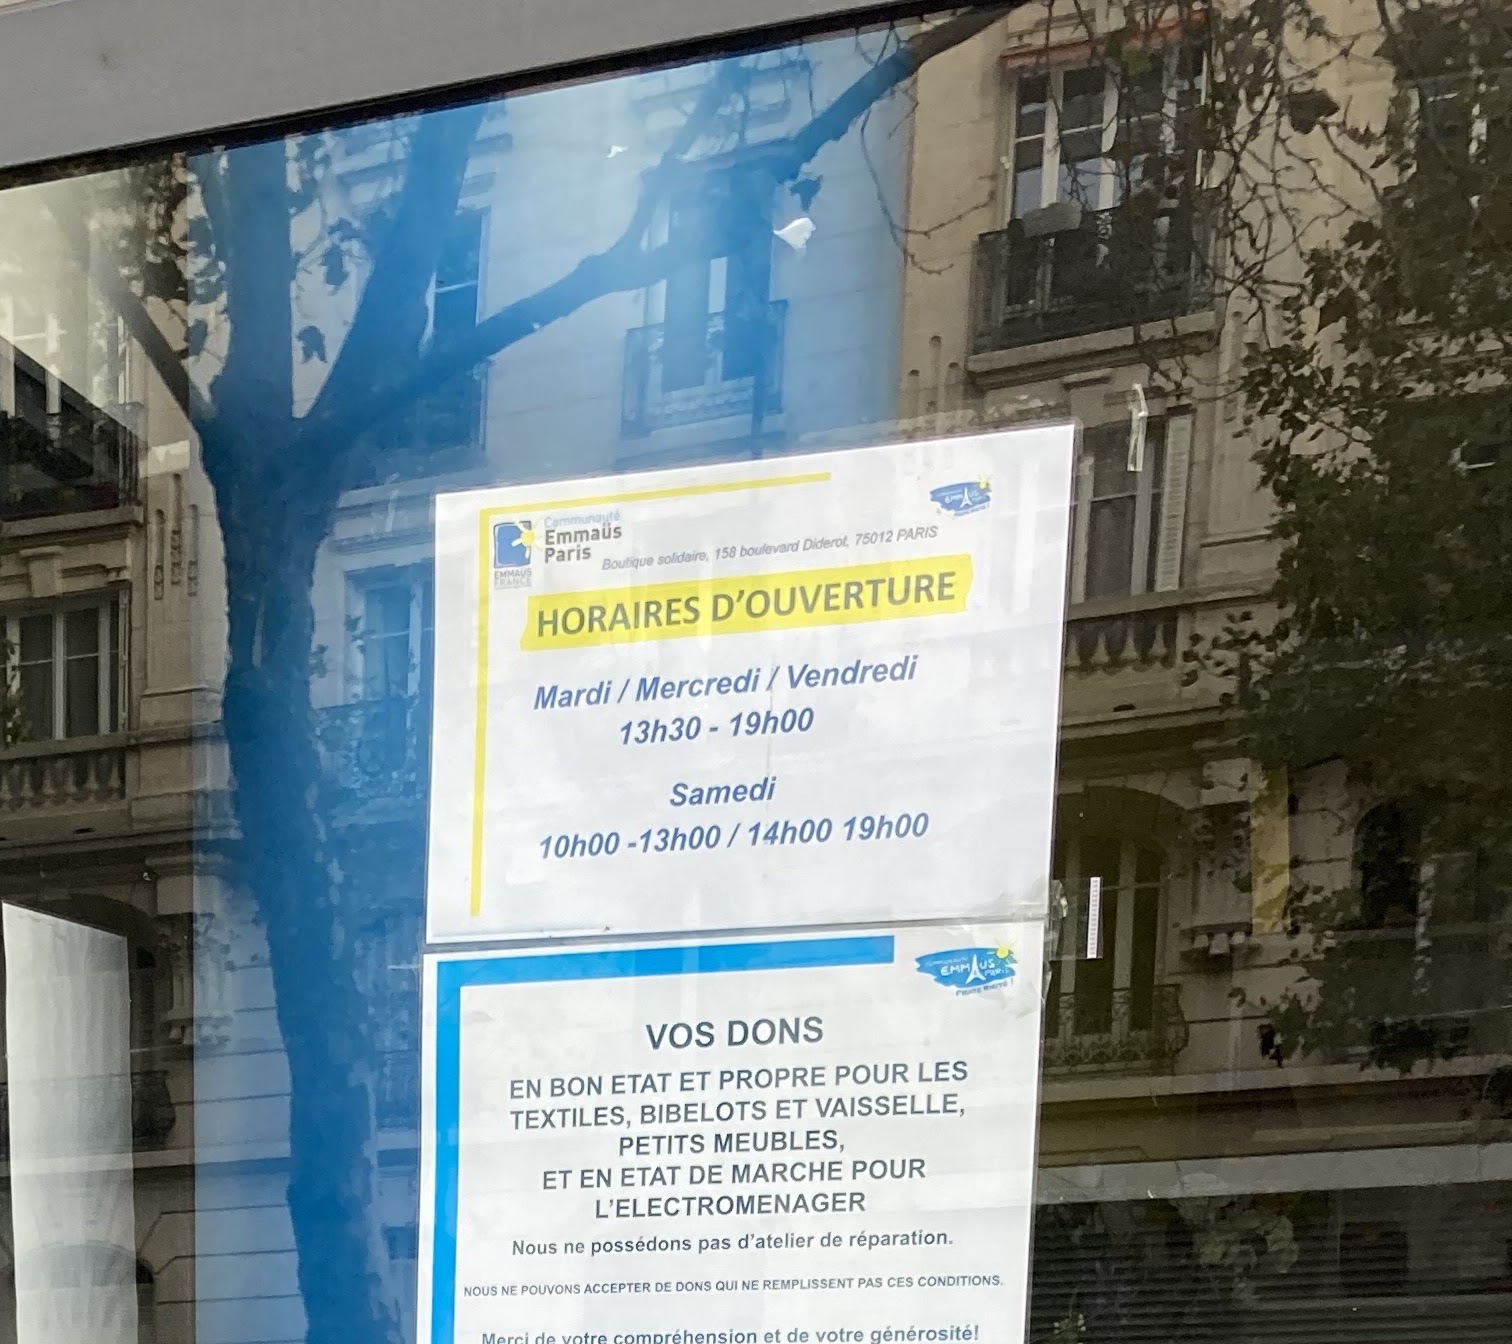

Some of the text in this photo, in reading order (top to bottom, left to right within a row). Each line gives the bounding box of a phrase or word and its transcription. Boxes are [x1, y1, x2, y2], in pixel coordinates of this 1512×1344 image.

[545, 522, 622, 545] Emmaüs
[602, 525, 938, 570] Boutique solidaire, 158 boulevard Diderot, 75012 PARIS
[545, 544, 591, 563] Paris
[538, 571, 956, 637] HORAIRES D'OUVERTURE
[534, 655, 918, 710] Mardi / Mercredi / Vendredi
[621, 716, 701, 745] 13h30
[730, 708, 814, 736] 19h00
[670, 776, 776, 806] Samedi
[541, 832, 620, 859] 10h00
[727, 823, 741, 848] /
[749, 818, 832, 846] 14h00
[844, 813, 928, 841] 19h00
[646, 1016, 823, 1049] VOS DONS
[511, 1061, 967, 1099] EN BON ETAT ET PROPRE POUR LES
[510, 1093, 964, 1129] TEXTILES, BIBELOTS ET VAISSELLE,
[620, 1130, 844, 1156] PETITS MEUBLES,
[543, 1159, 925, 1190] ET EN ETAT DE MARCHE POUR
[596, 1192, 865, 1218] L'ELECTROMENAGER
[513, 1230, 952, 1256] Nous ne possédons pas d'atelier de réparation.
[464, 1275, 1003, 1297] NOUS NE POUVONS ACCEPTER DE DONS QUI NE REMPLISSENT PAS CES CONDITIONS.
[764, 1329, 781, 1343] et
[787, 1328, 809, 1343] de
[816, 1328, 864, 1342] votre
[871, 1325, 978, 1344] générosité!
